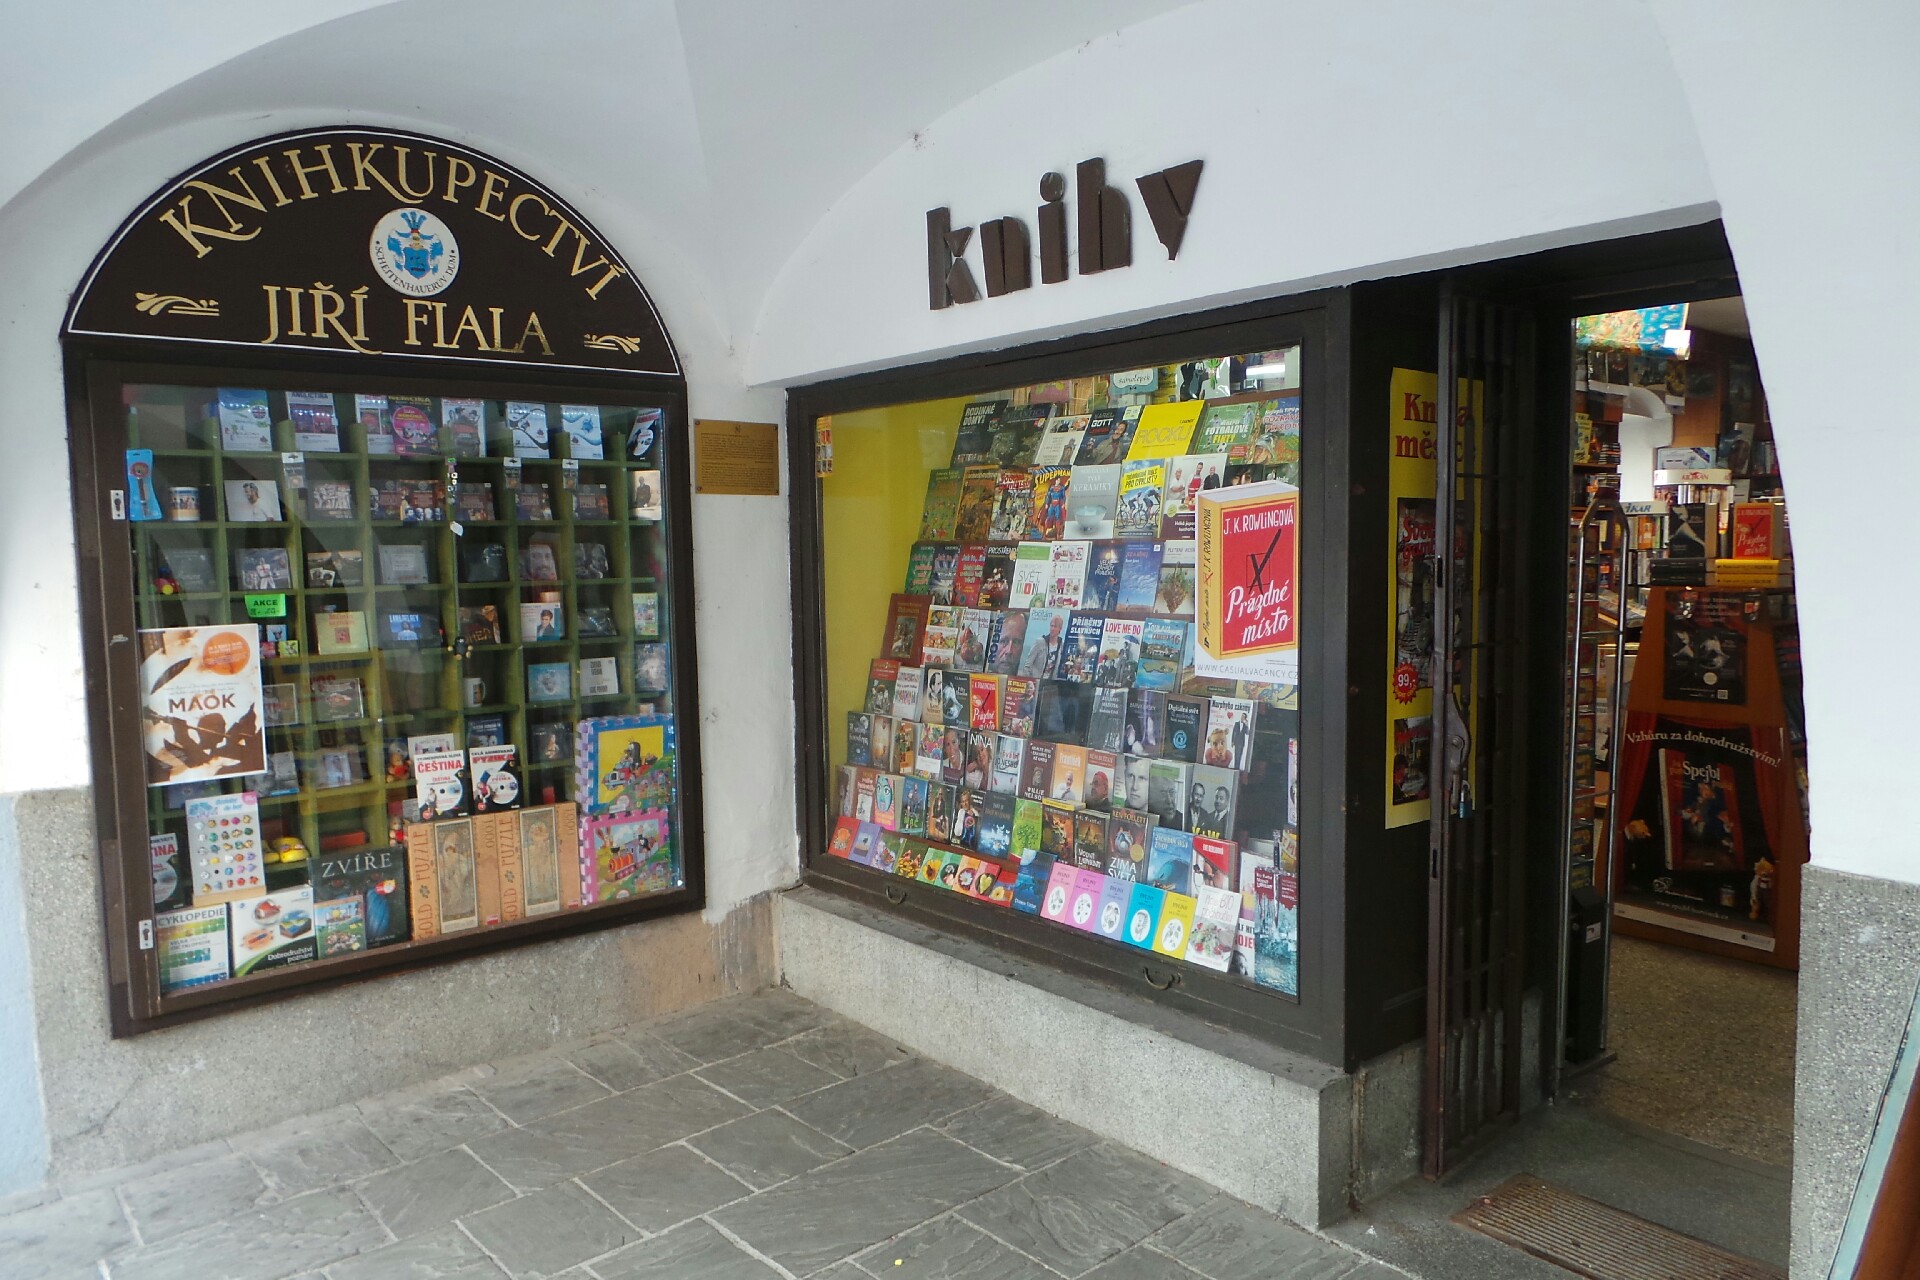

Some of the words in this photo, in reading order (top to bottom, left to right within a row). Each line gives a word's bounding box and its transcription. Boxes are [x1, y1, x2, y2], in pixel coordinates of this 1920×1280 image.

[159, 142, 627, 301] KNIHKUPECTVÍ
[261, 282, 383, 355] JIŘÍ
[403, 299, 556, 357] FIALA
[1091, 418, 1114, 428] GOTT
[1034, 469, 1071, 490] SUPERMAN
[1225, 579, 1291, 624] Prázdné
[1105, 622, 1122, 633] LOVE
[1121, 624, 1131, 634] ME
[1132, 625, 1141, 635] DO
[1241, 607, 1292, 646] místo
[970, 733, 993, 750] NINA
[1627, 730, 1668, 744] Vzhůru
[1670, 732, 1682, 740] za
[1684, 731, 1782, 768] dobrodružstvím!
[417, 759, 463, 773] ČEŠTINA
[1683, 760, 1721, 783] Spejbl
[1024, 791, 1043, 801] NELSO
[321, 852, 392, 878] ZVÍŘE
[1110, 857, 1137, 873] ZIMA
[157, 907, 225, 926] CYKLOPEDIE
[268, 946, 313, 961] Dobrodružství
